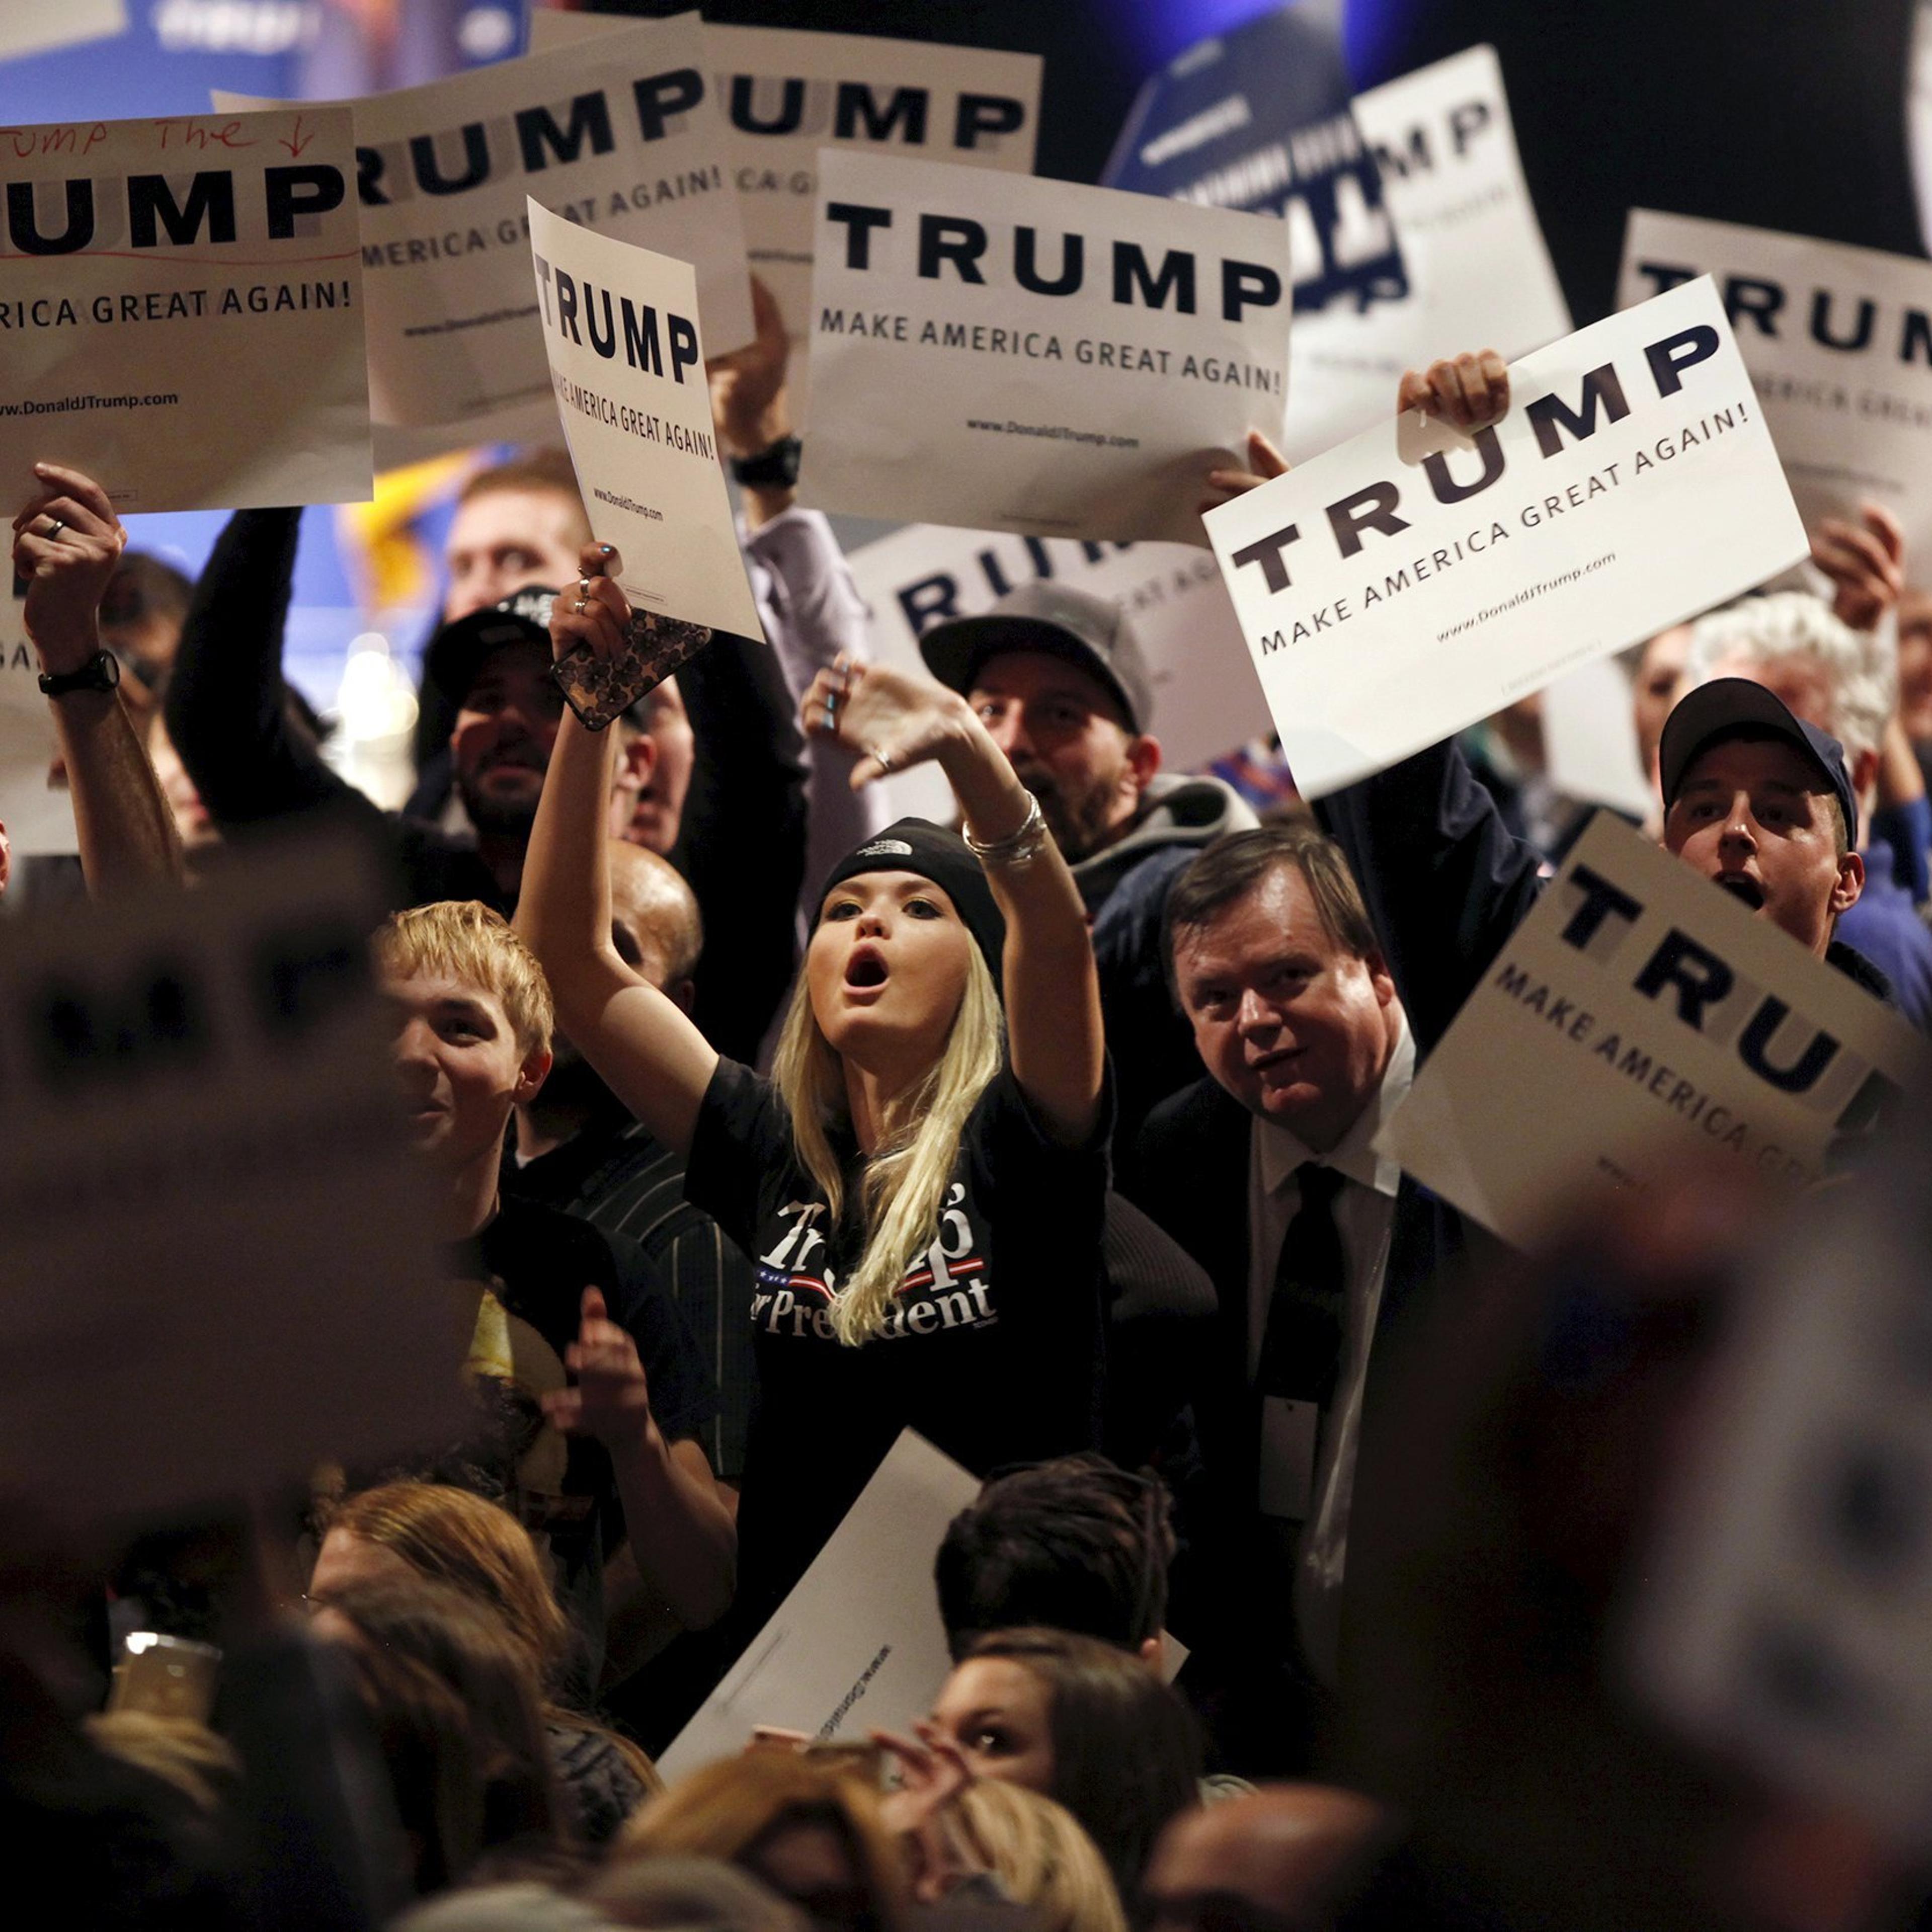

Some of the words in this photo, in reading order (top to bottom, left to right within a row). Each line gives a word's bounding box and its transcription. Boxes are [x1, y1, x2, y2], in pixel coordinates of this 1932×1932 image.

[155, 121, 260, 148] The
[731, 75, 1025, 149] UMP
[7, 165, 345, 256] UMP
[497, 199, 597, 245] GAT
[609, 164, 720, 217] AGAIN!
[92, 290, 207, 324] GREAT
[221, 280, 351, 314] AGAIN!
[826, 202, 1282, 322] TRUMP
[535, 254, 698, 384] TRUMP
[820, 308, 908, 342] MAKE
[920, 320, 1063, 360] AMERICA
[1075, 339, 1171, 373] GREAT
[1181, 355, 1281, 395] AGAIN!
[570, 383, 618, 428] AMERICA
[620, 405, 660, 443] GREAT
[666, 421, 714, 461] AGAIN!
[1232, 325, 1720, 594] TRUMP
[1260, 598, 1353, 657] MAKE
[1363, 521, 1510, 609] AMERICA
[1521, 463, 1621, 529] GREAT
[1634, 402, 1750, 476] AGAIN!
[1437, 552, 1617, 643] www.DonaldJTrump.com
[1495, 963, 1594, 1042] MAKE
[1594, 1034, 1747, 1152] AMERICA
[765, 1278, 997, 1339] Predent
